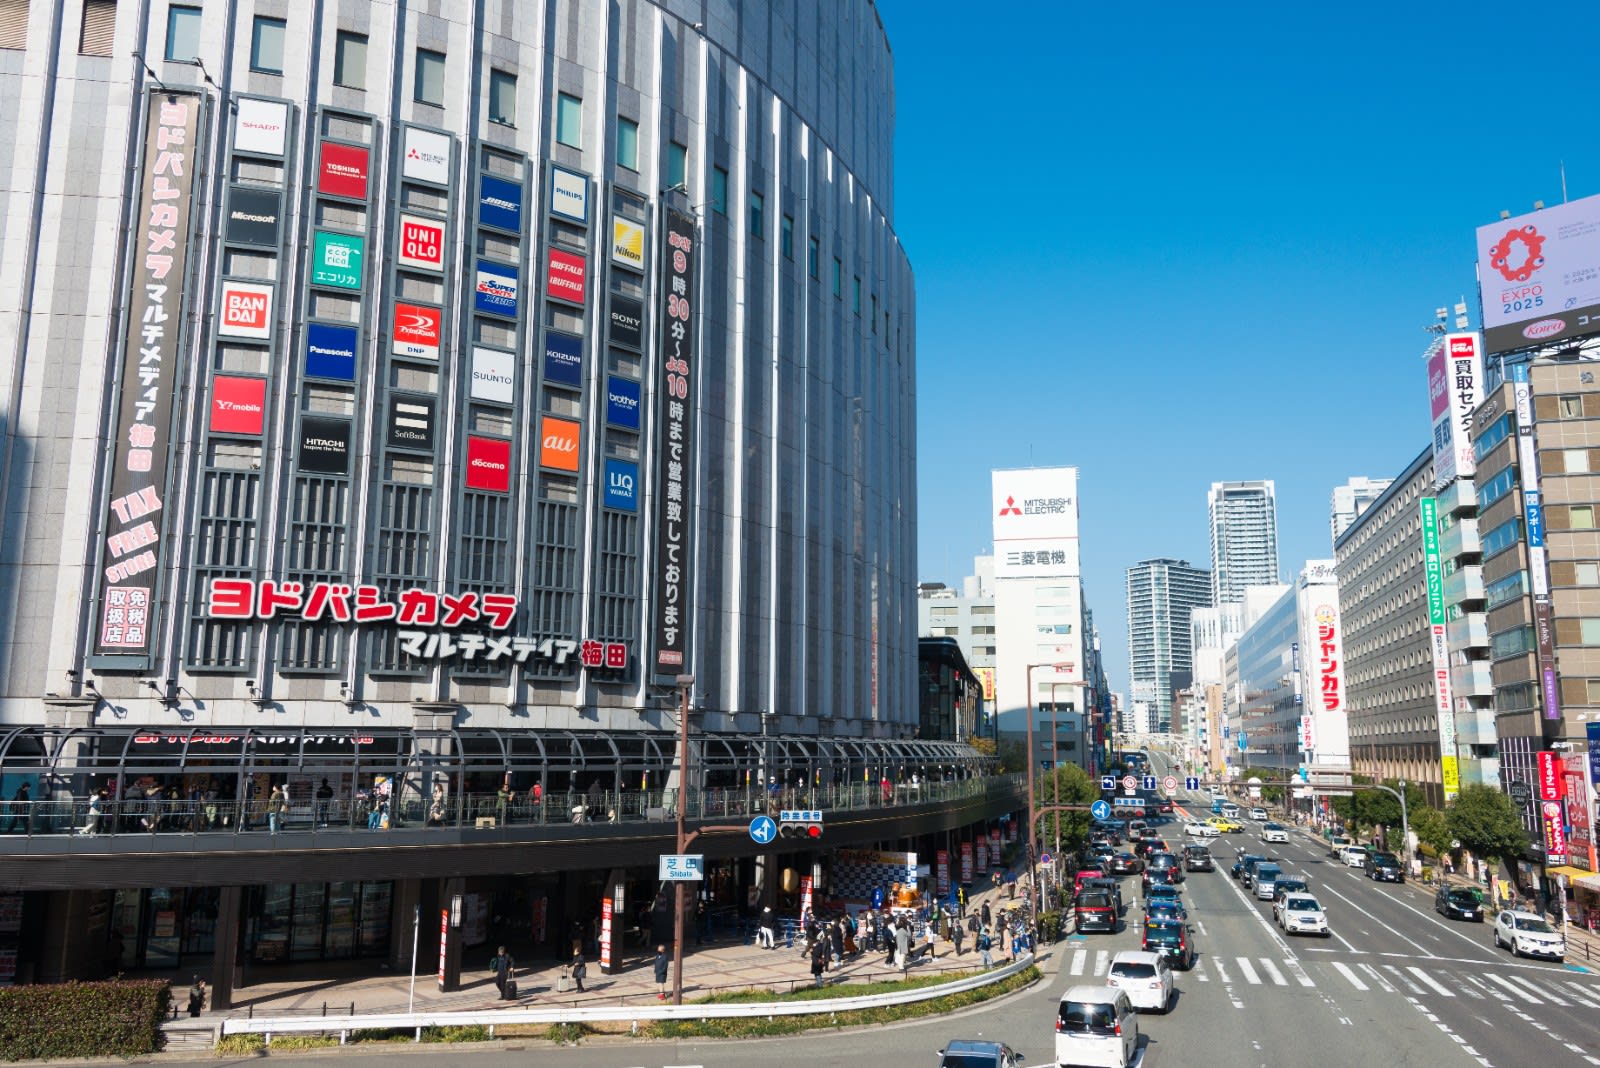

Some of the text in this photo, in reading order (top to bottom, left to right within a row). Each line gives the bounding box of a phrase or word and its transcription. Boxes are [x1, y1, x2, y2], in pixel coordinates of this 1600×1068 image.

[242, 122, 280, 132] SHARP
[327, 163, 360, 174] TOSHIBA
[556, 187, 583, 201] PHILIPS
[231, 211, 276, 223] Microsoft
[407, 227, 435, 244] UNI
[328, 249, 347, 257] eco
[407, 242, 437, 258] QLO
[615, 246, 641, 261] Nikon
[327, 257, 346, 265] rica
[550, 261, 583, 276] BUFFALO
[316, 271, 357, 285] エコリカ
[1502, 285, 1543, 303] EXPO
[229, 296, 264, 312] BAN
[1503, 296, 1544, 314] 2025
[228, 309, 256, 323] DAI
[611, 312, 640, 326] SONY
[309, 345, 353, 357] Panasonic
[407, 346, 425, 354] DNP
[546, 350, 580, 363] KOIZUMI
[473, 371, 512, 385] SUUNTO
[609, 392, 638, 406] brother
[1455, 359, 1475, 443] 買取センター
[394, 429, 427, 440] SoftBank
[306, 438, 344, 448] HITACHI
[543, 435, 577, 452] au
[471, 458, 505, 470] docomo
[610, 472, 633, 490] UQ
[111, 485, 162, 524] TAX
[1024, 498, 1072, 507] MITSUBISHI
[1024, 506, 1065, 515] ELECTRIC
[108, 521, 158, 558] FREE
[1007, 550, 1066, 566] 三菱電機
[106, 550, 156, 584] STORE
[209, 578, 518, 630] ヨドバシカメラ
[105, 590, 127, 644] 取扱店
[126, 590, 146, 644] 免税品
[1318, 623, 1340, 712] ジャンカラ
[666, 858, 697, 870] 芝田
[669, 870, 692, 878] Shibata
